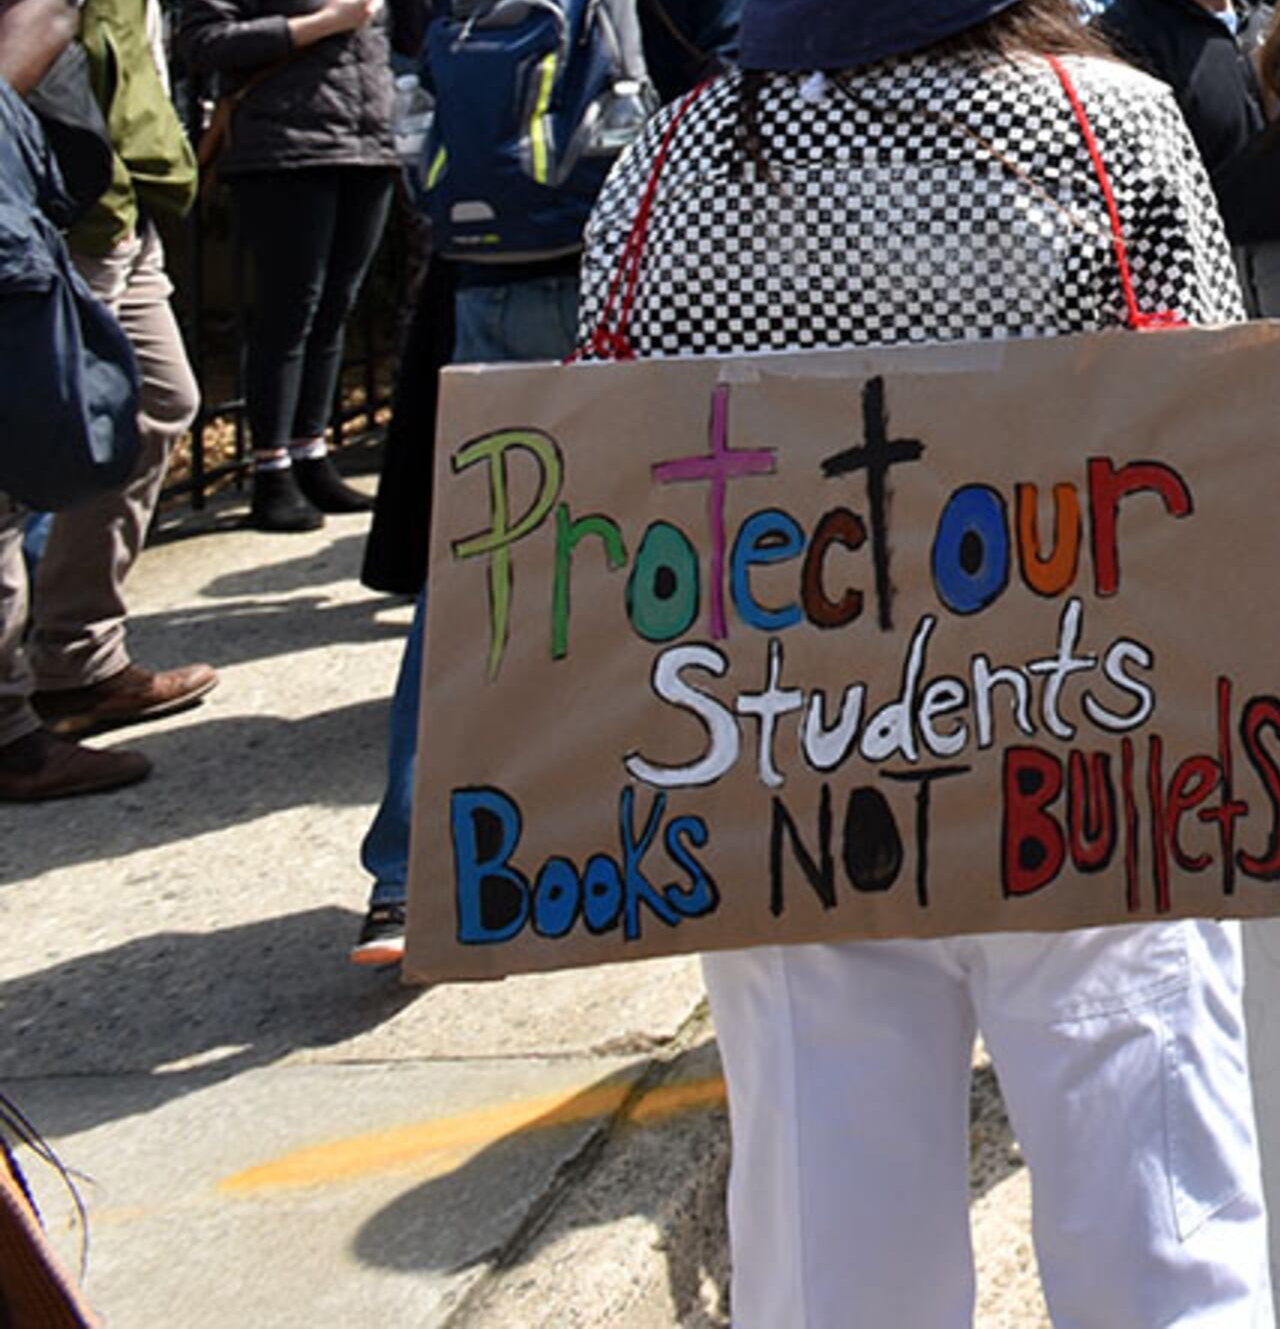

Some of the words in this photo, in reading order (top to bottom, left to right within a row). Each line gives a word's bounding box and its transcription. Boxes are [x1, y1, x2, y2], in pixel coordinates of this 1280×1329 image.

[449, 374, 925, 681] Protect
[932, 456, 1193, 616] our
[625, 598, 1157, 788] Students
[769, 762, 972, 917] NOT
